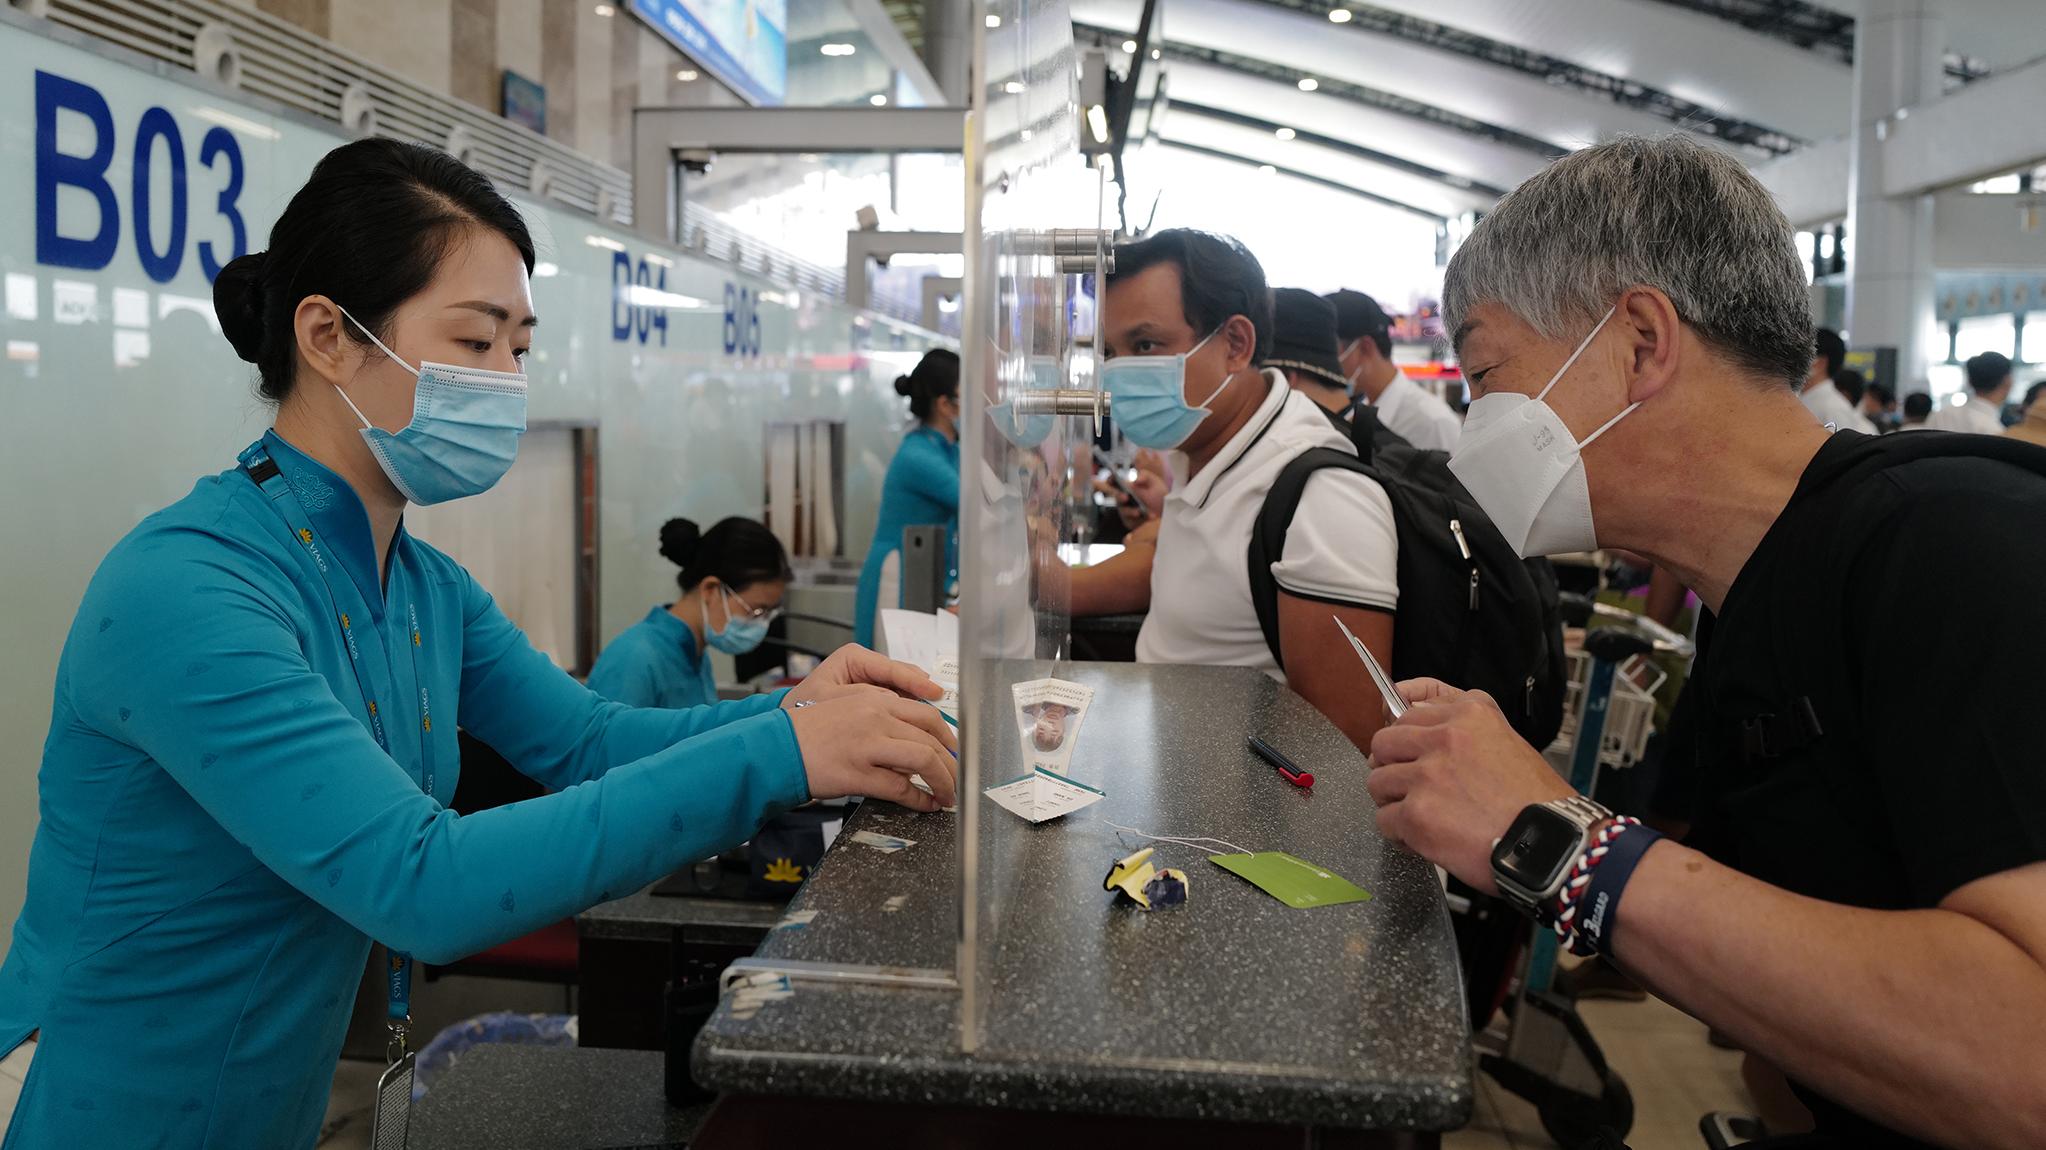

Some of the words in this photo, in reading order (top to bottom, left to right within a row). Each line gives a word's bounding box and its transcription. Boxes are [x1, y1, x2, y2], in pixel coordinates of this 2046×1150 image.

[35, 69, 248, 285] B03
[613, 250, 668, 347] B04
[310, 543, 328, 572] VIAGS
[347, 628, 359, 660] VIAGS
[374, 716, 385, 747] VIAGS
[426, 774, 434, 797] AGS
[392, 971, 402, 999] VIAGS
